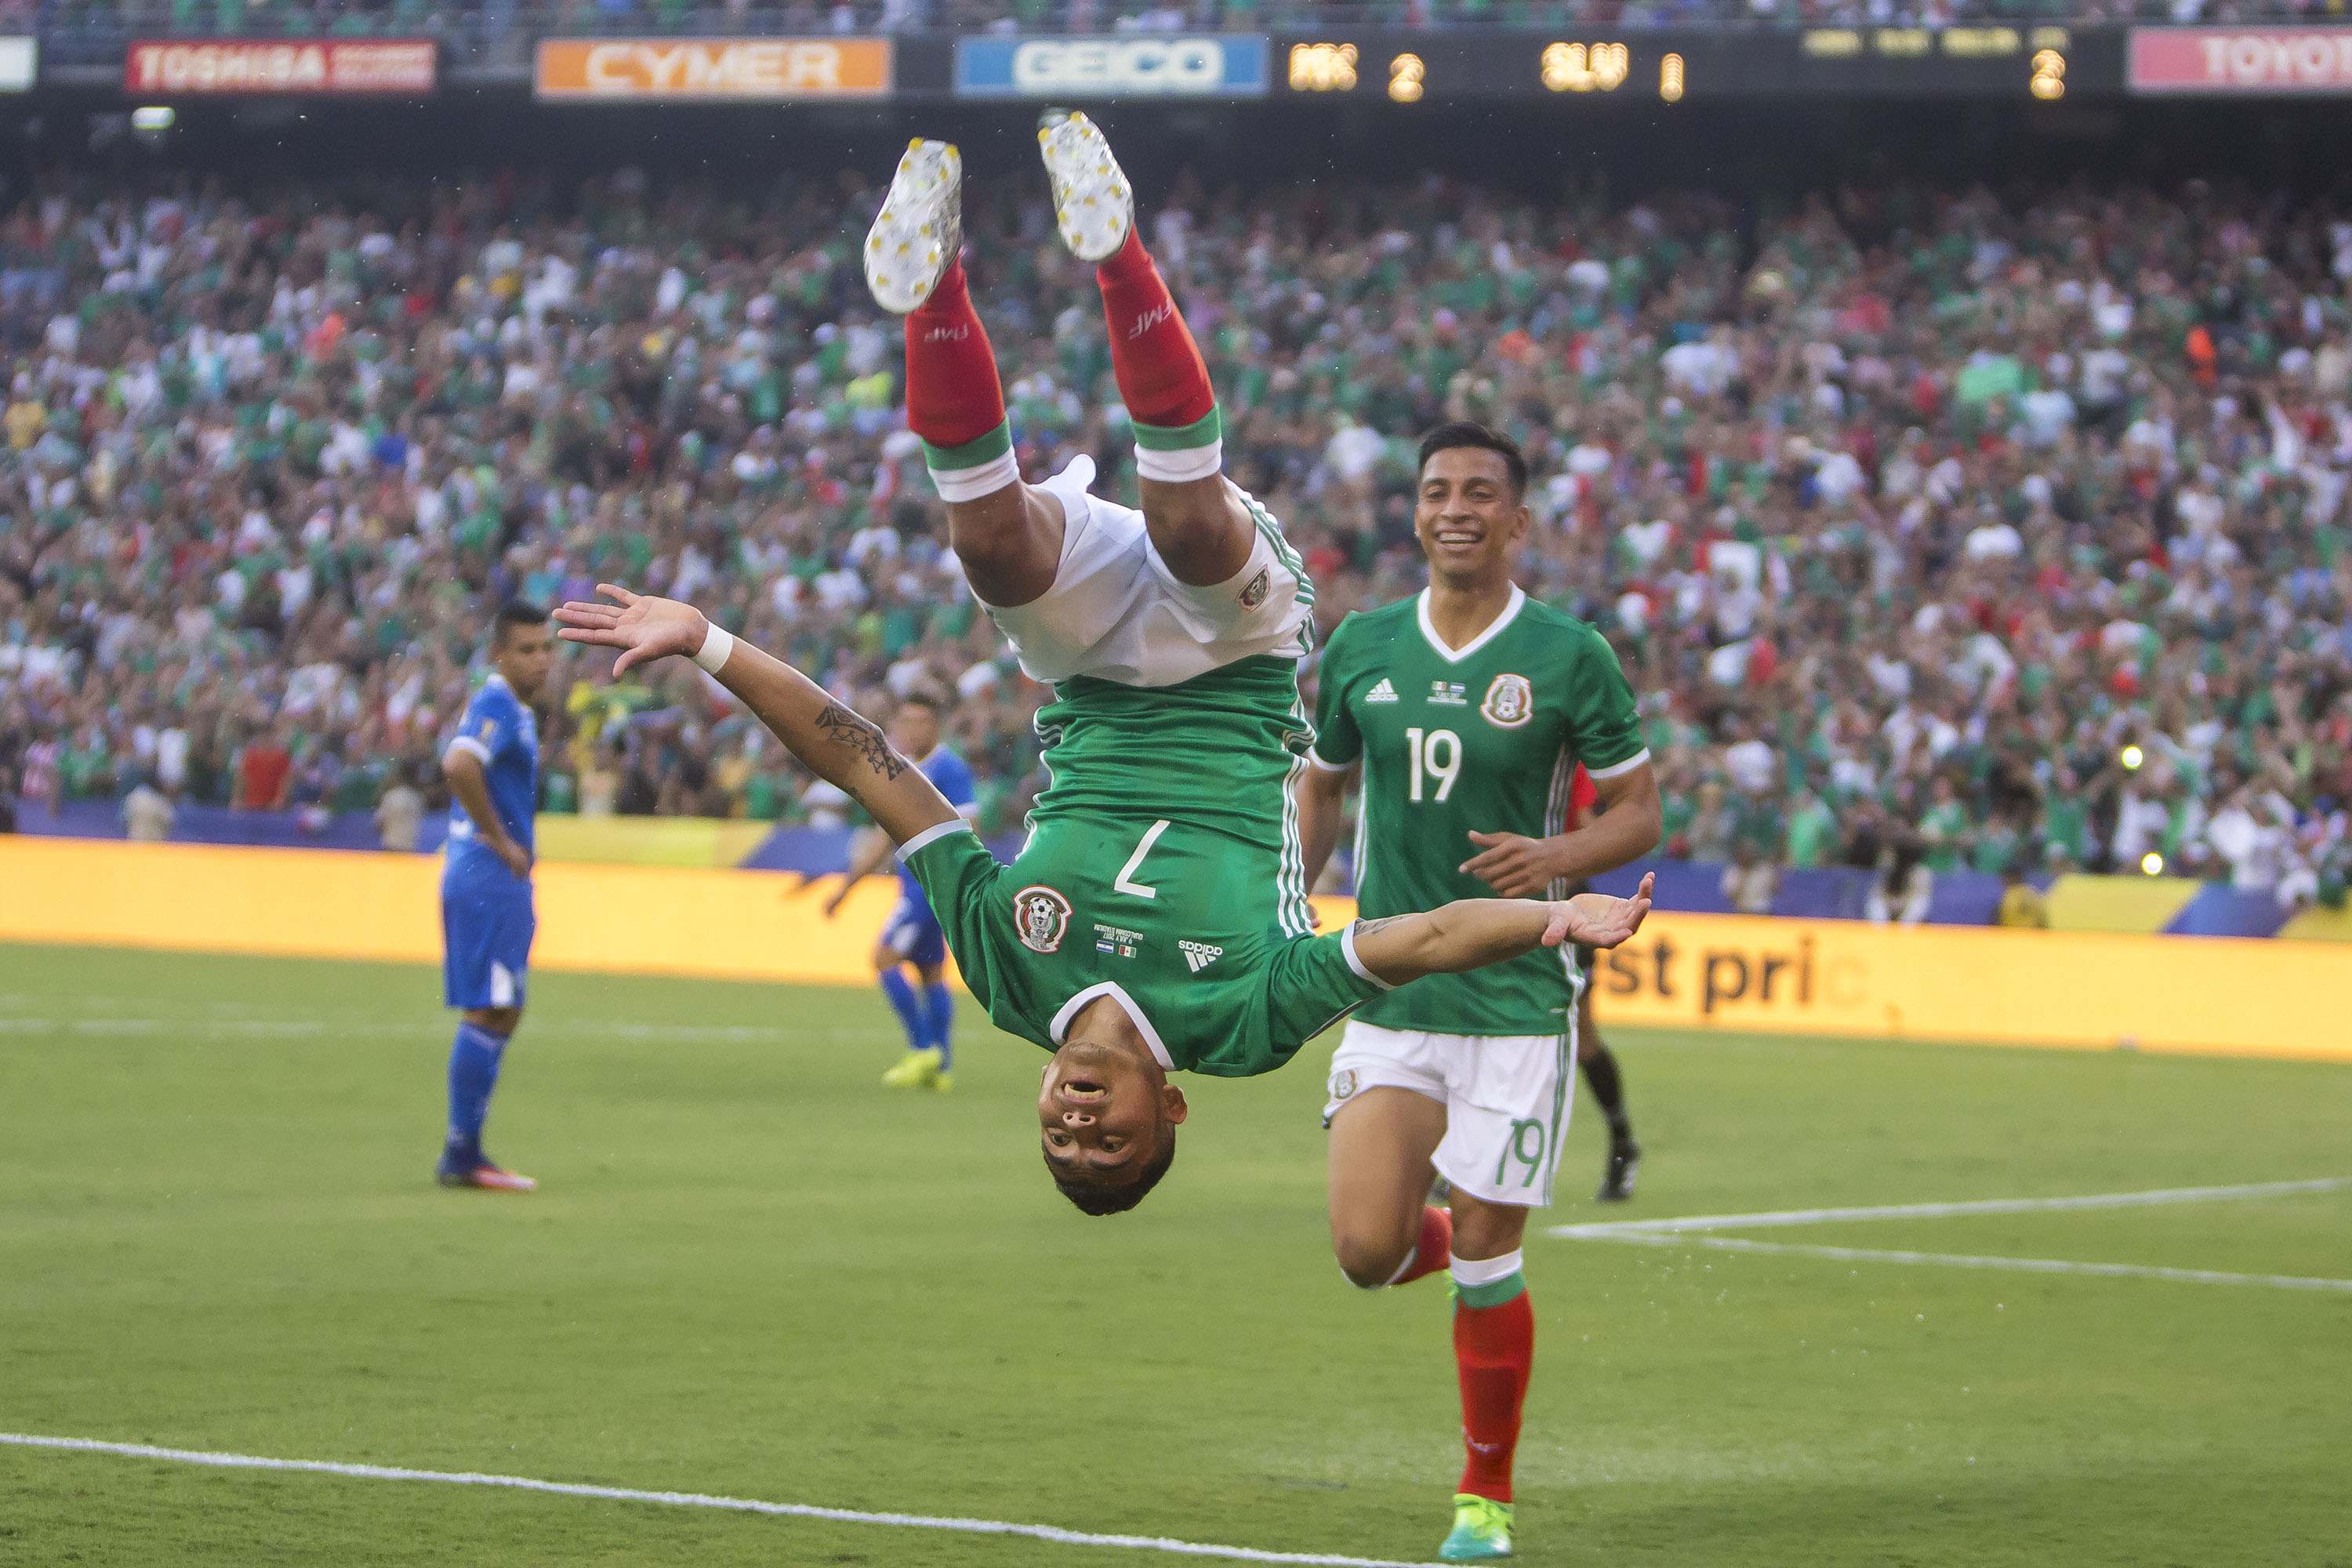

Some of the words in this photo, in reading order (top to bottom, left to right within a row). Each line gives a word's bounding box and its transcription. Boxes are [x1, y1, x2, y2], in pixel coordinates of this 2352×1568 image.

[586, 42, 841, 92] CYMER
[1014, 40, 1222, 90] GEICO
[1388, 53, 1425, 102] 2
[2031, 49, 2065, 100] 2
[1129, 297, 1173, 340] FMF
[1405, 727, 1463, 803] 19
[1113, 819, 1171, 899] 7
[1178, 940, 1223, 956] adidas
[1607, 935, 1675, 997] st
[1495, 1117, 1545, 1189] 19
